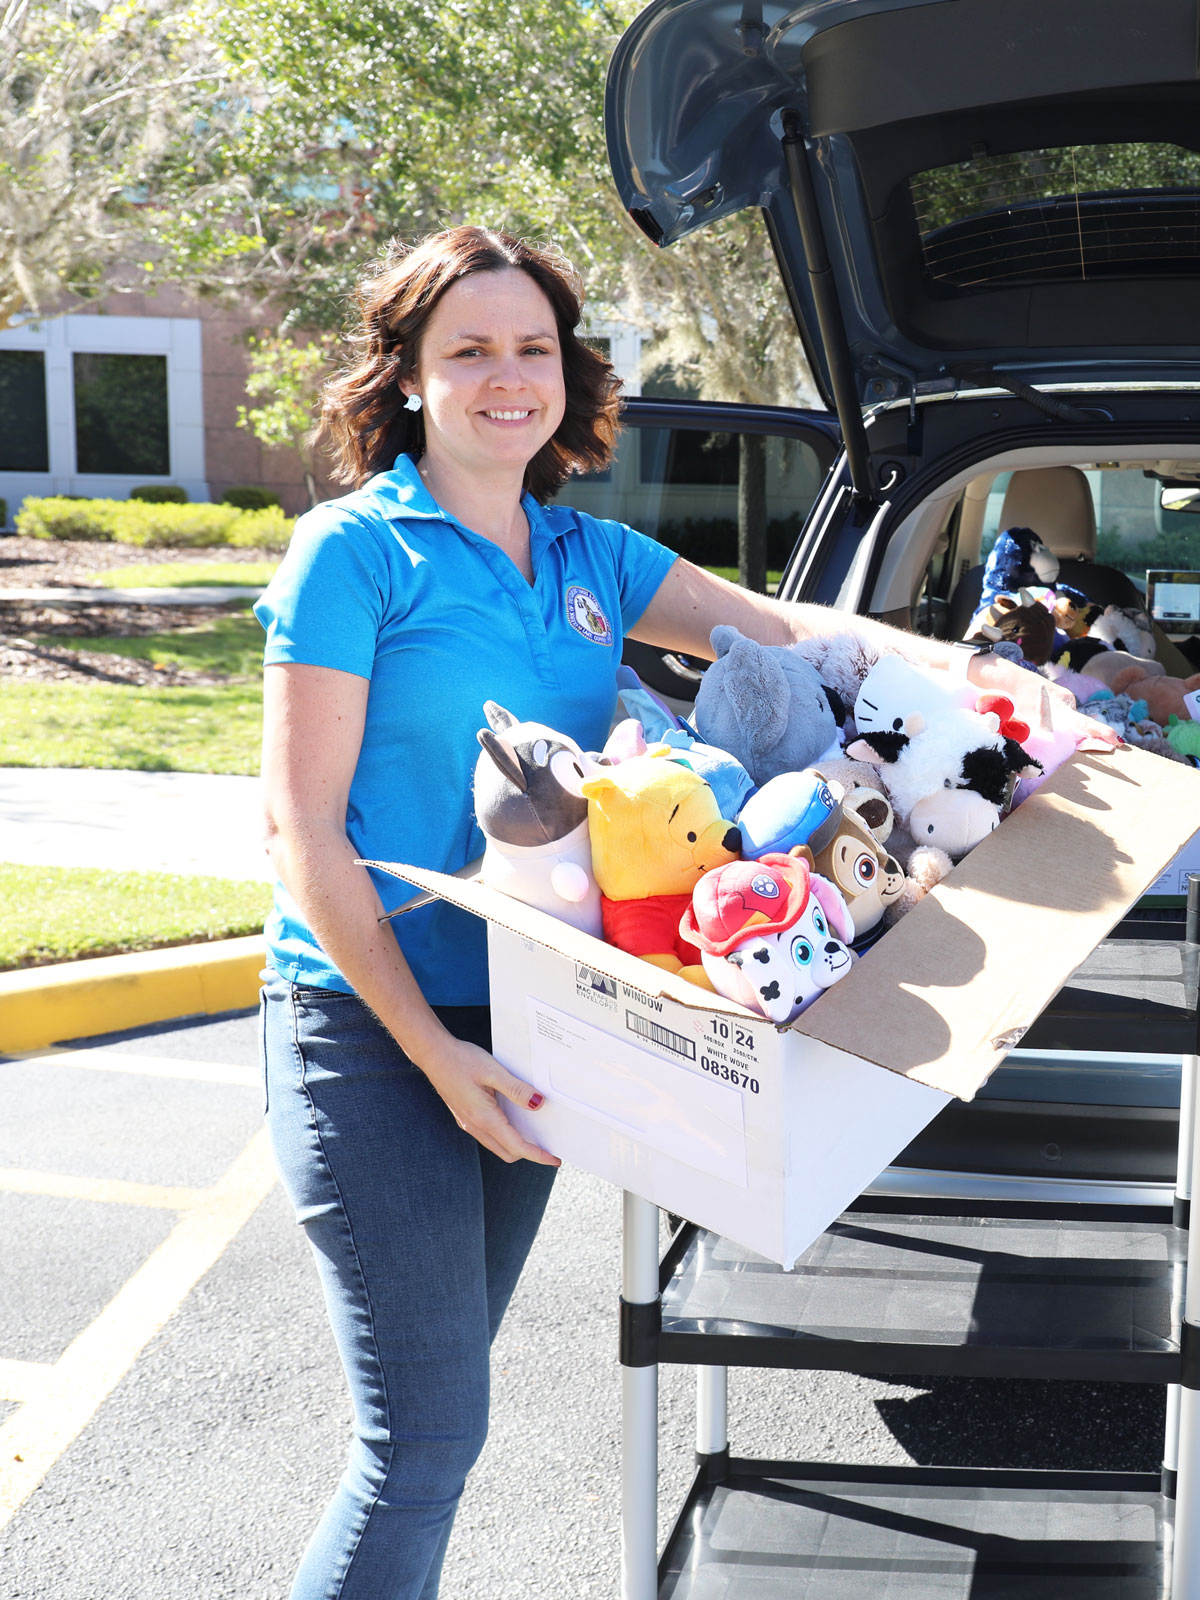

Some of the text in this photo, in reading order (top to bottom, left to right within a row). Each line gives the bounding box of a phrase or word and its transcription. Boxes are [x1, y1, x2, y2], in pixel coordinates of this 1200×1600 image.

[576, 983, 592, 995] MAC
[576, 988, 618, 1013] ENVELOPES
[622, 986, 663, 1013] WINDOW
[710, 1019, 729, 1039] 10
[735, 1030, 755, 1051] 24
[703, 1034, 725, 1048] 500/BOX
[706, 1046, 750, 1071] WHITE WOVE
[700, 1055, 760, 1094] 083670
